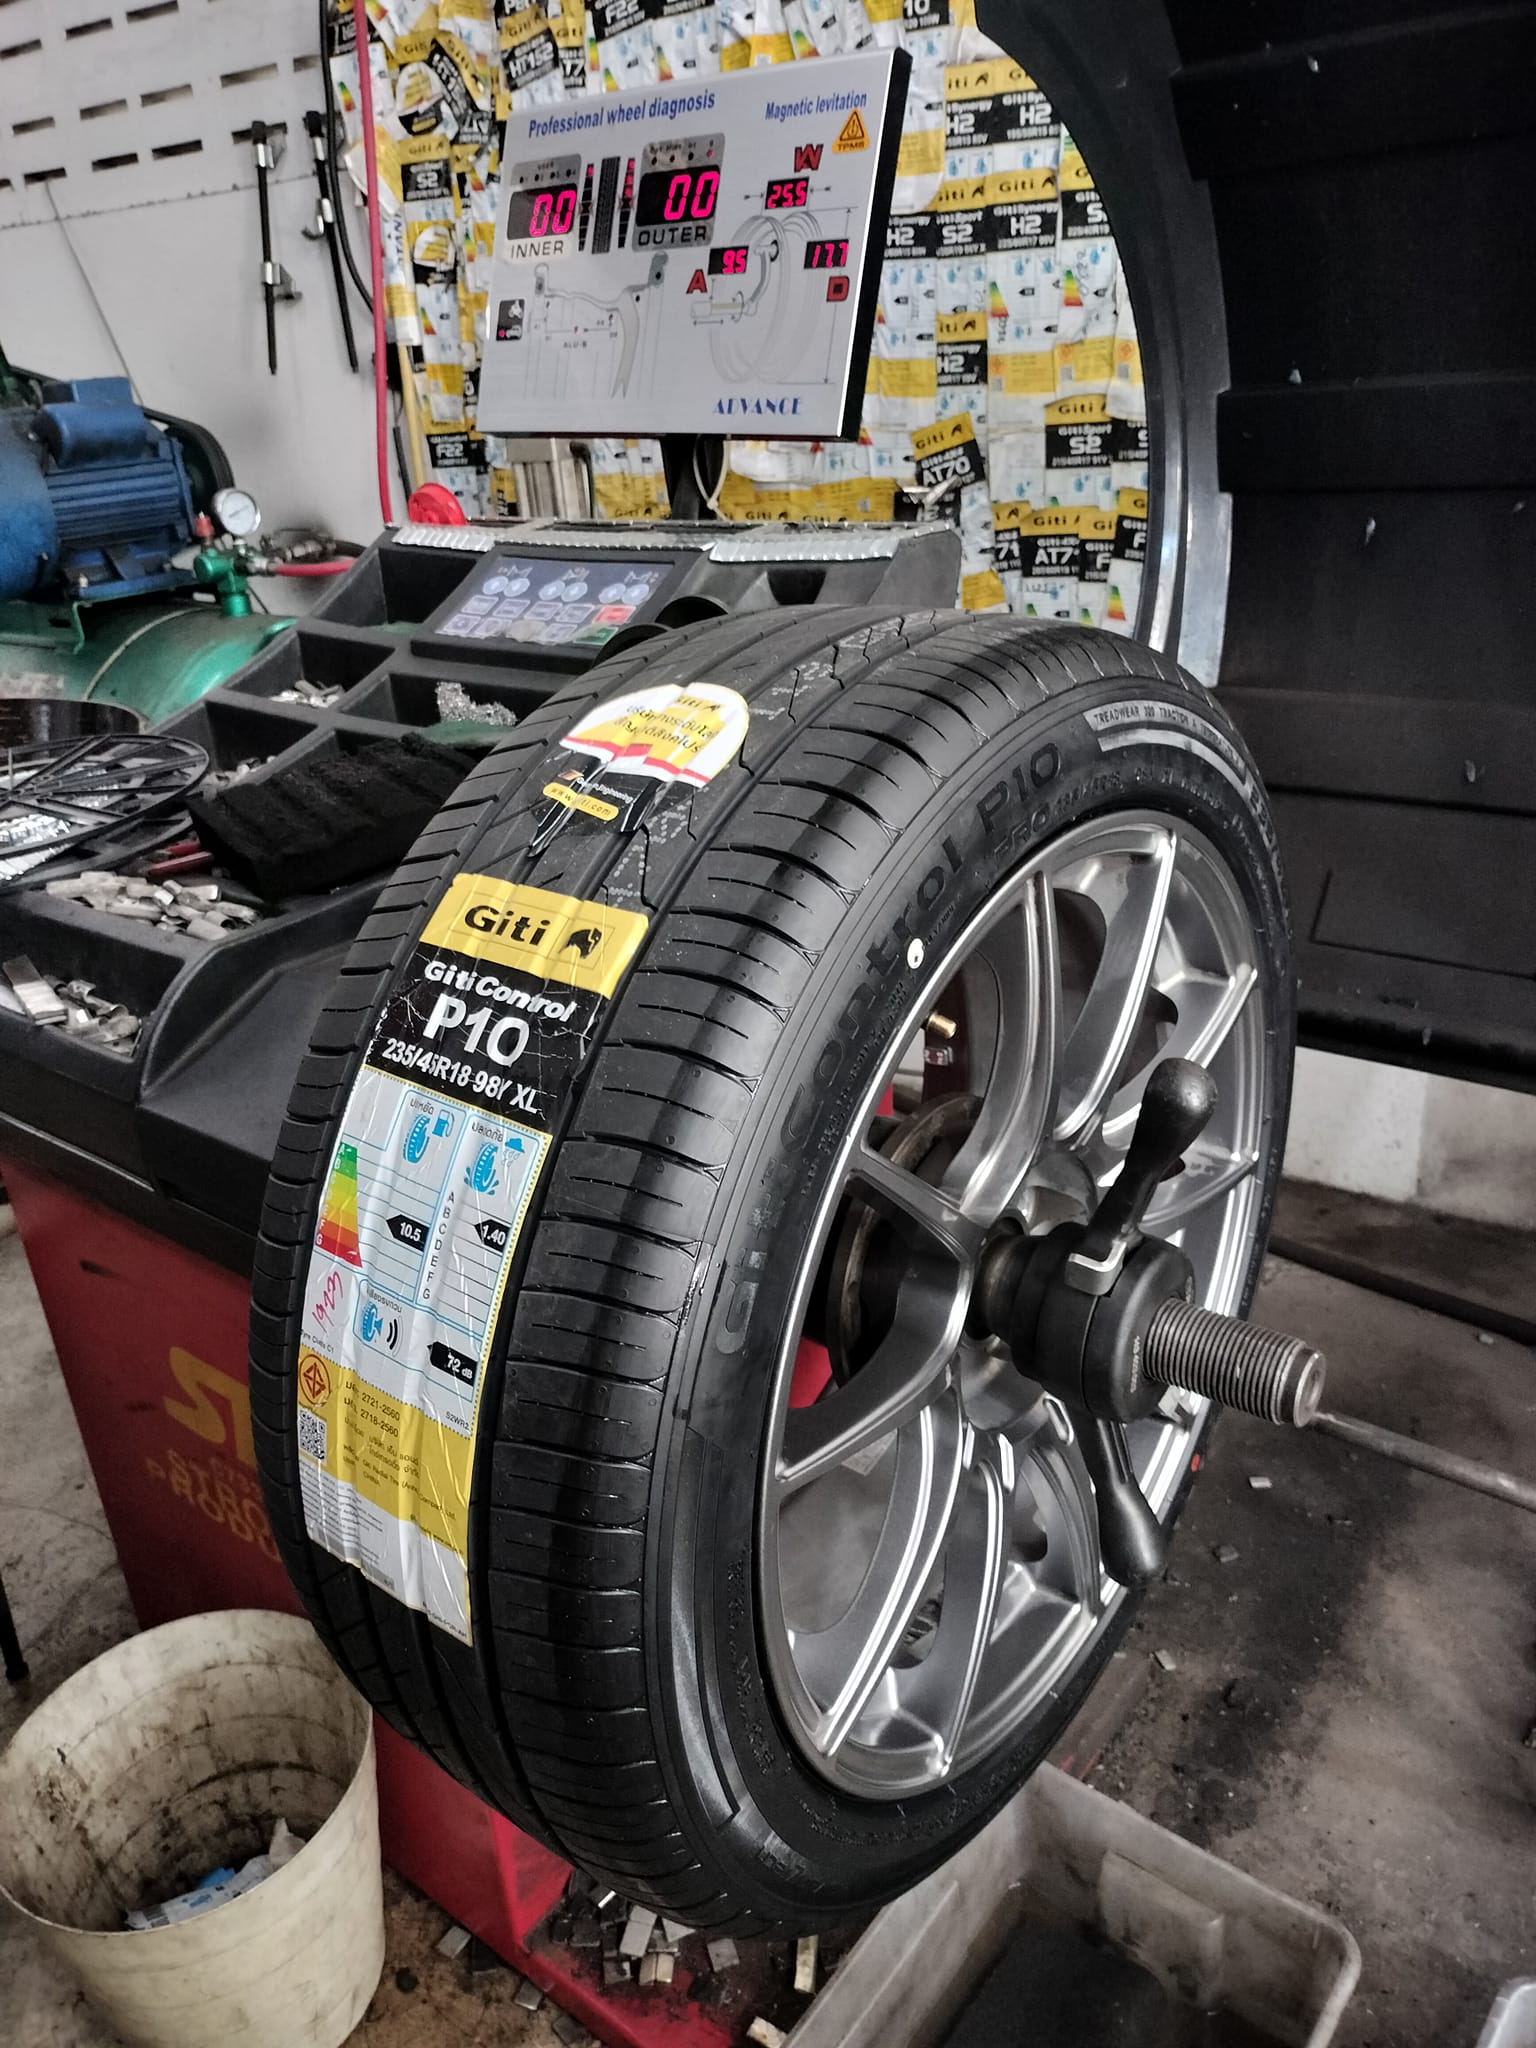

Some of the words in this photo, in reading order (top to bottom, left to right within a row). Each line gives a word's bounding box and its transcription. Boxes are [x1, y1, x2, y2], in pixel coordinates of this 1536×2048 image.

[948, 76, 967, 90] iti
[529, 107, 604, 139] Professional
[607, 98, 645, 124] wheel
[649, 88, 715, 121] diagnosis
[765, 100, 813, 122] Magnetic
[815, 91, 868, 112] levitation
[1020, 102, 1052, 127] H2
[947, 112, 975, 135] H2
[794, 143, 824, 173] W
[416, 172, 439, 189] S2
[999, 178, 1034, 193] Giti
[664, 171, 720, 221] 00
[939, 189, 964, 202] iti
[528, 190, 577, 238] 00
[942, 223, 973, 245] S2
[1010, 214, 1042, 236] H2
[637, 225, 708, 246] OUTER
[886, 226, 915, 246] H2
[510, 239, 564, 259] INNER
[686, 269, 708, 294] A
[826, 276, 850, 302] D
[939, 322, 957, 333] iti
[937, 355, 965, 373] H2
[713, 398, 801, 415] ADVANCE
[1058, 403, 1094, 414] Giti
[916, 431, 944, 450] Giti
[1069, 434, 1102, 455] S2
[436, 443, 464, 459] F22
[922, 455, 971, 487] AT70
[1033, 515, 1067, 526] Giti
[1093, 521, 1112, 531] Gi
[1094, 705, 1142, 725] TREADWEAR
[976, 741, 1061, 835] P10
[464, 904, 551, 947] Giti
[423, 960, 576, 1023] GitiControl
[422, 993, 530, 1067] P10
[509, 1083, 541, 1115] XL
[449, 1191, 455, 1203] A
[442, 1207, 450, 1220] B
[400, 1221, 422, 1242] 10.5
[439, 1223, 446, 1235] C
[481, 1224, 506, 1246] 1.40
[434, 1239, 442, 1251] D
[430, 1255, 437, 1267] E
[426, 1271, 433, 1283] F
[423, 1288, 430, 1300] G
[447, 1353, 463, 1374] 72
[461, 1367, 473, 1380] dB
